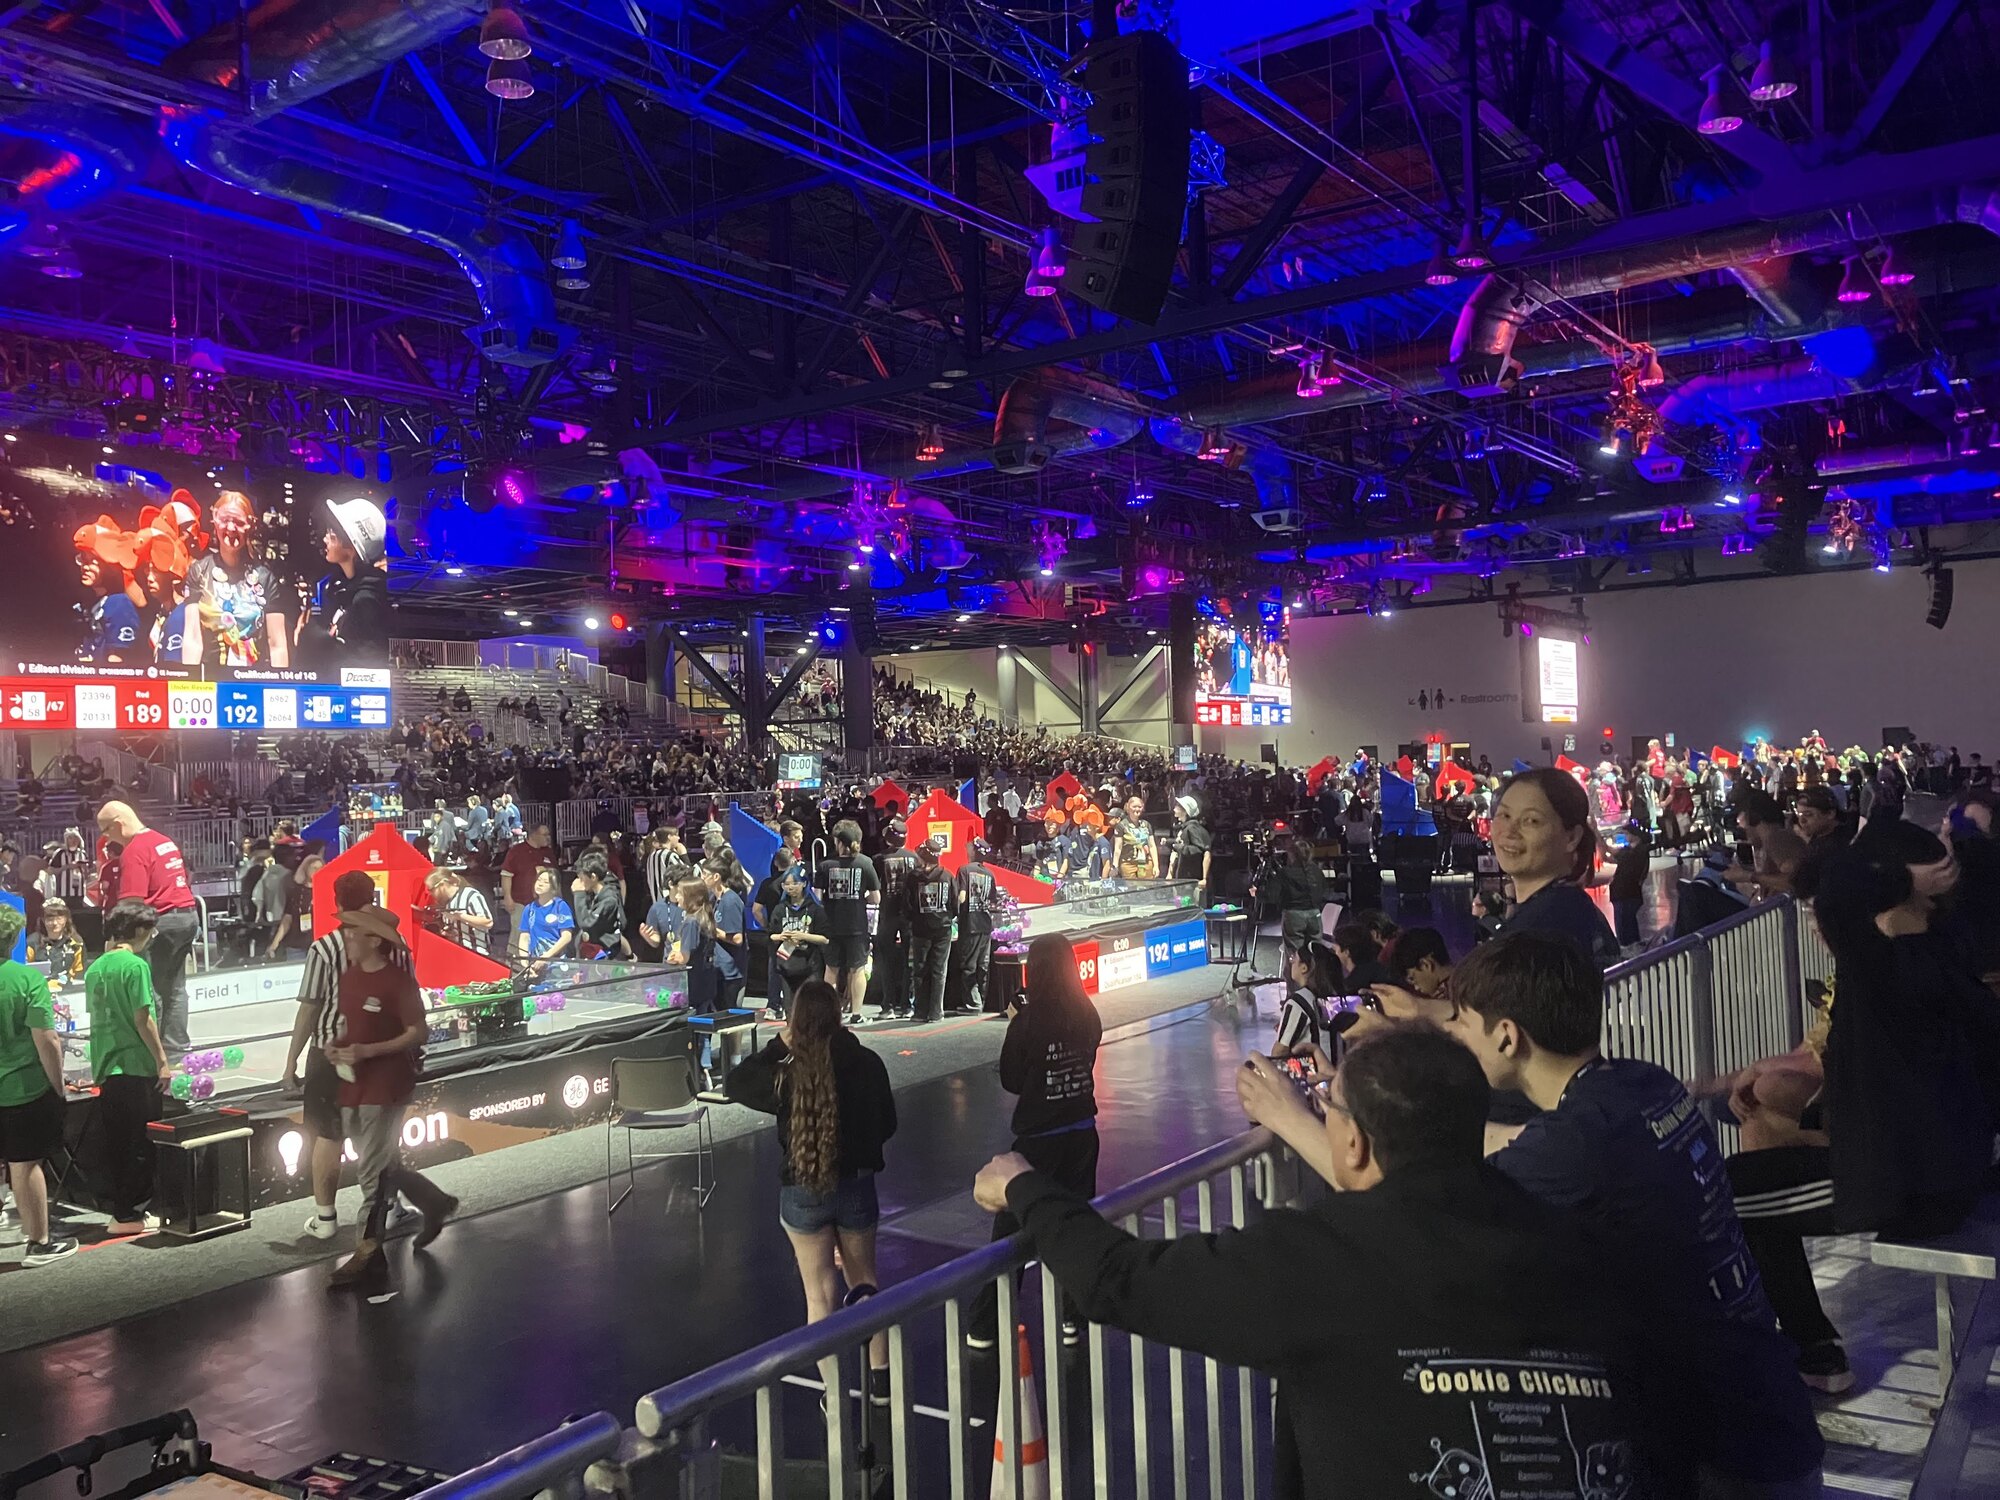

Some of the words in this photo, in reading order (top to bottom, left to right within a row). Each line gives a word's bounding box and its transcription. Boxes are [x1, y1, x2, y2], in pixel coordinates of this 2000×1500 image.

[60, 665, 96, 675] Division
[234, 670, 279, 680] Qualification
[280, 671, 294, 680] 104
[294, 671, 302, 680] of
[82, 692, 111, 700] 23396
[269, 695, 289, 703] 6962
[1460, 694, 1518, 704] Restrooms
[173, 697, 212, 714] 0:00
[82, 713, 111, 721] 20131
[124, 704, 162, 723] 189
[224, 705, 258, 723] 192
[268, 714, 292, 722] 26064
[790, 758, 811, 770] 0:00
[1113, 938, 1130, 952] 0:00
[1148, 942, 1169, 964] 192
[1079, 959, 1095, 980] 89
[195, 985, 229, 1000] Field
[234, 983, 240, 995] 1
[469, 1098, 530, 1120] SPONSORED
[531, 1093, 546, 1106] BY
[593, 1077, 609, 1095] GE
[1419, 1368, 1511, 1394] Cookie
[1518, 1369, 1613, 1398] Clickers
